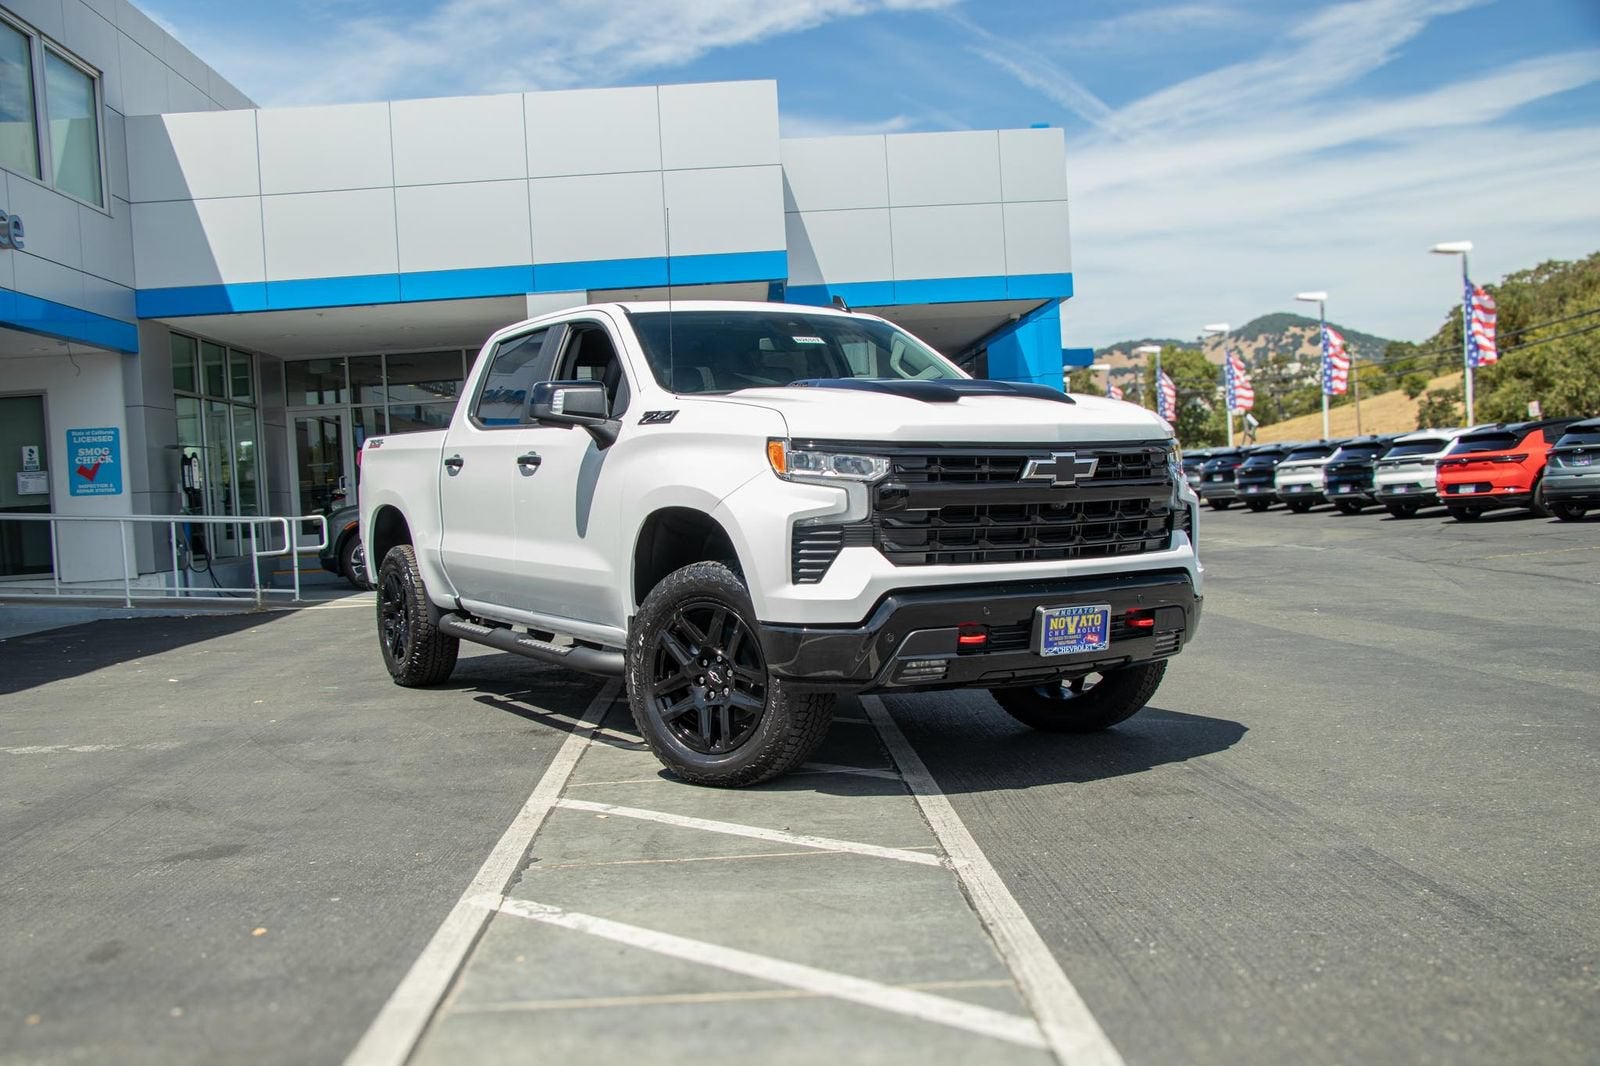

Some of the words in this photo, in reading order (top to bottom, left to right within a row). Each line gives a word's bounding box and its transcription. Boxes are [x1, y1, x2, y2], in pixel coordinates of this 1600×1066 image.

[73, 435, 114, 443] LICENSED
[78, 448, 110, 456] SMOG
[75, 455, 114, 464] CHECK
[1061, 608, 1094, 616] NOVATO
[1050, 614, 1102, 635] NOVATO
[1057, 644, 1093, 653] CHEVROLET
